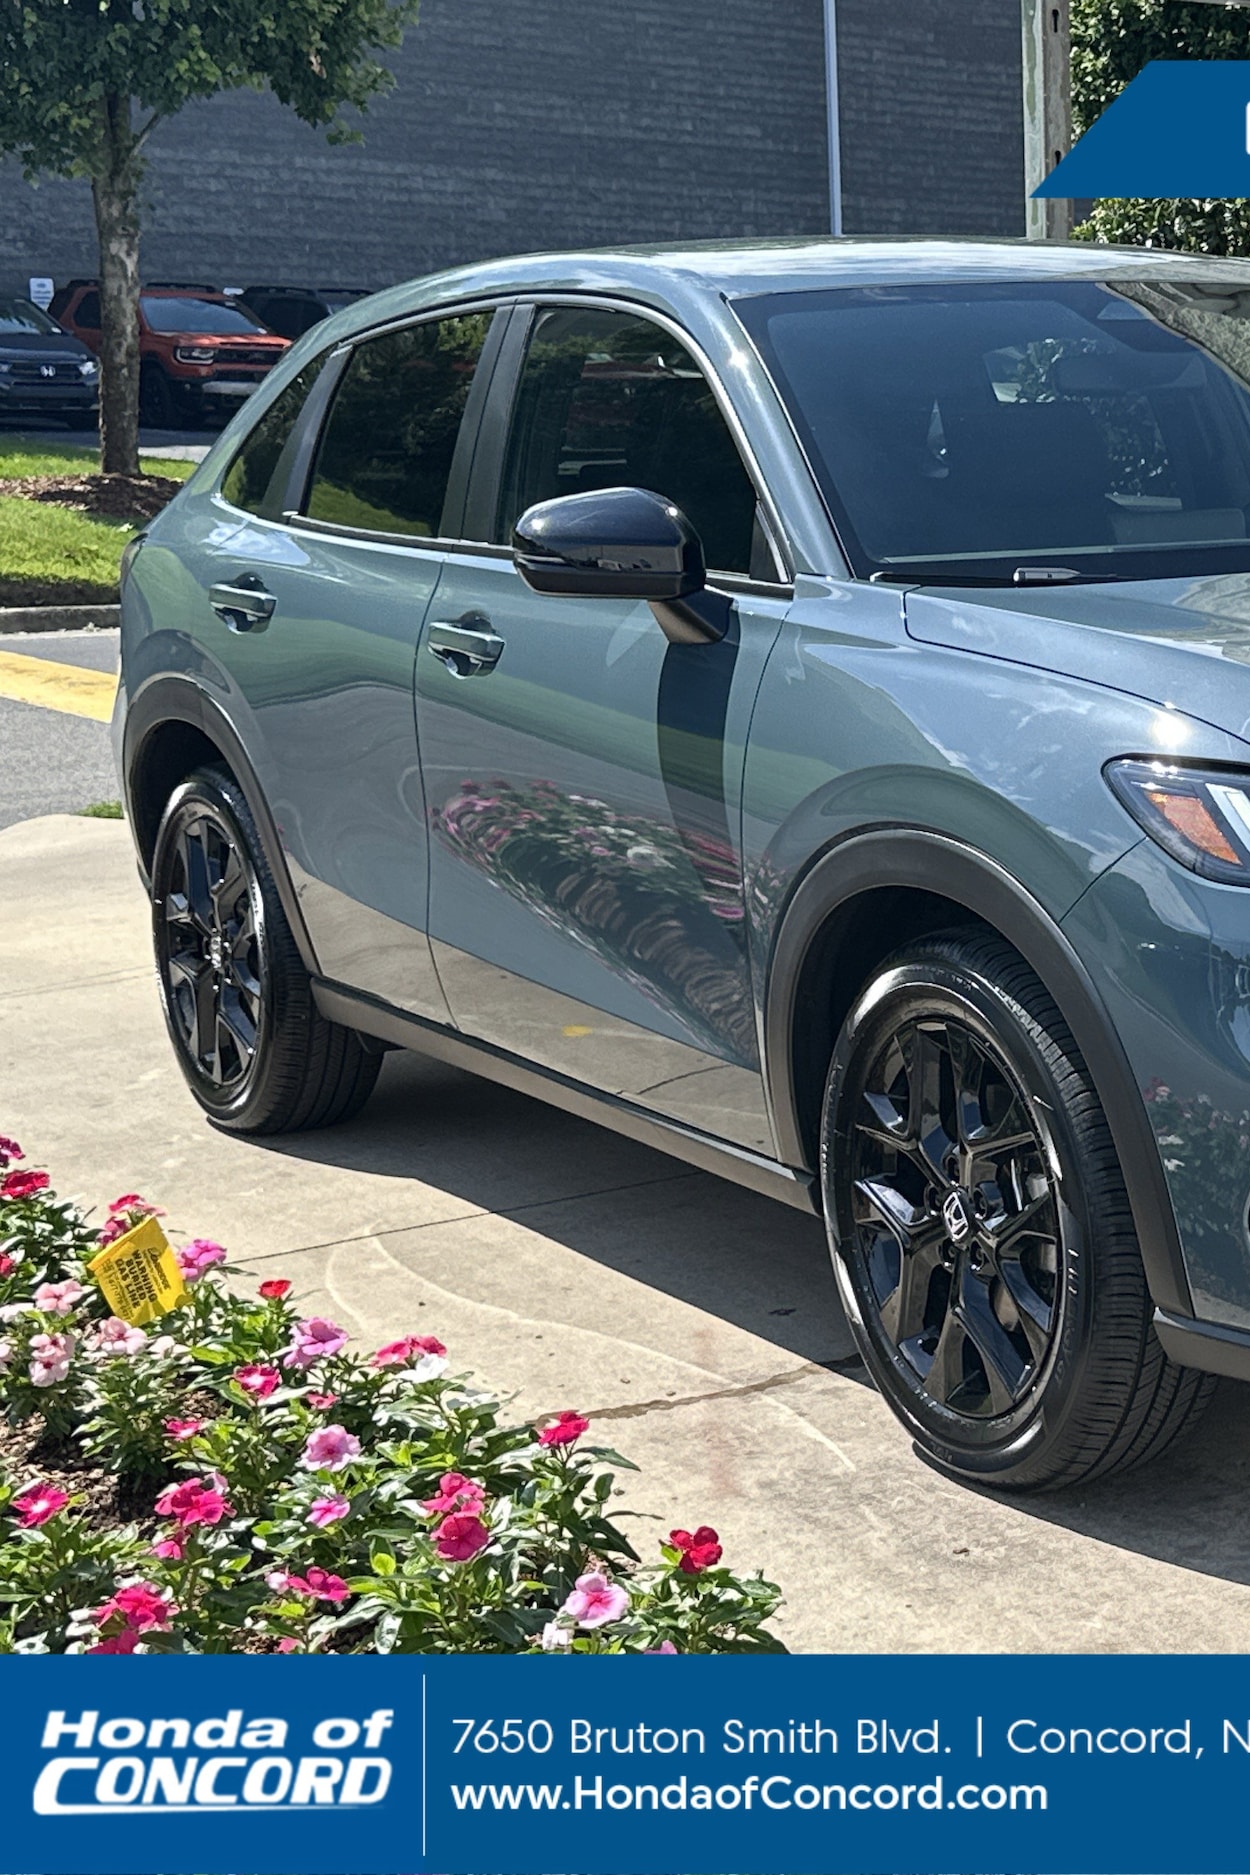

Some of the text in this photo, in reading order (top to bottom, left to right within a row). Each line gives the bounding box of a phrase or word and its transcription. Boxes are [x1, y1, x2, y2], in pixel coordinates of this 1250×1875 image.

[115, 1259, 129, 1281] GAS
[125, 1283, 140, 1308] LINE
[126, 1259, 146, 1300] BURIED
[132, 1249, 157, 1302] WARNING
